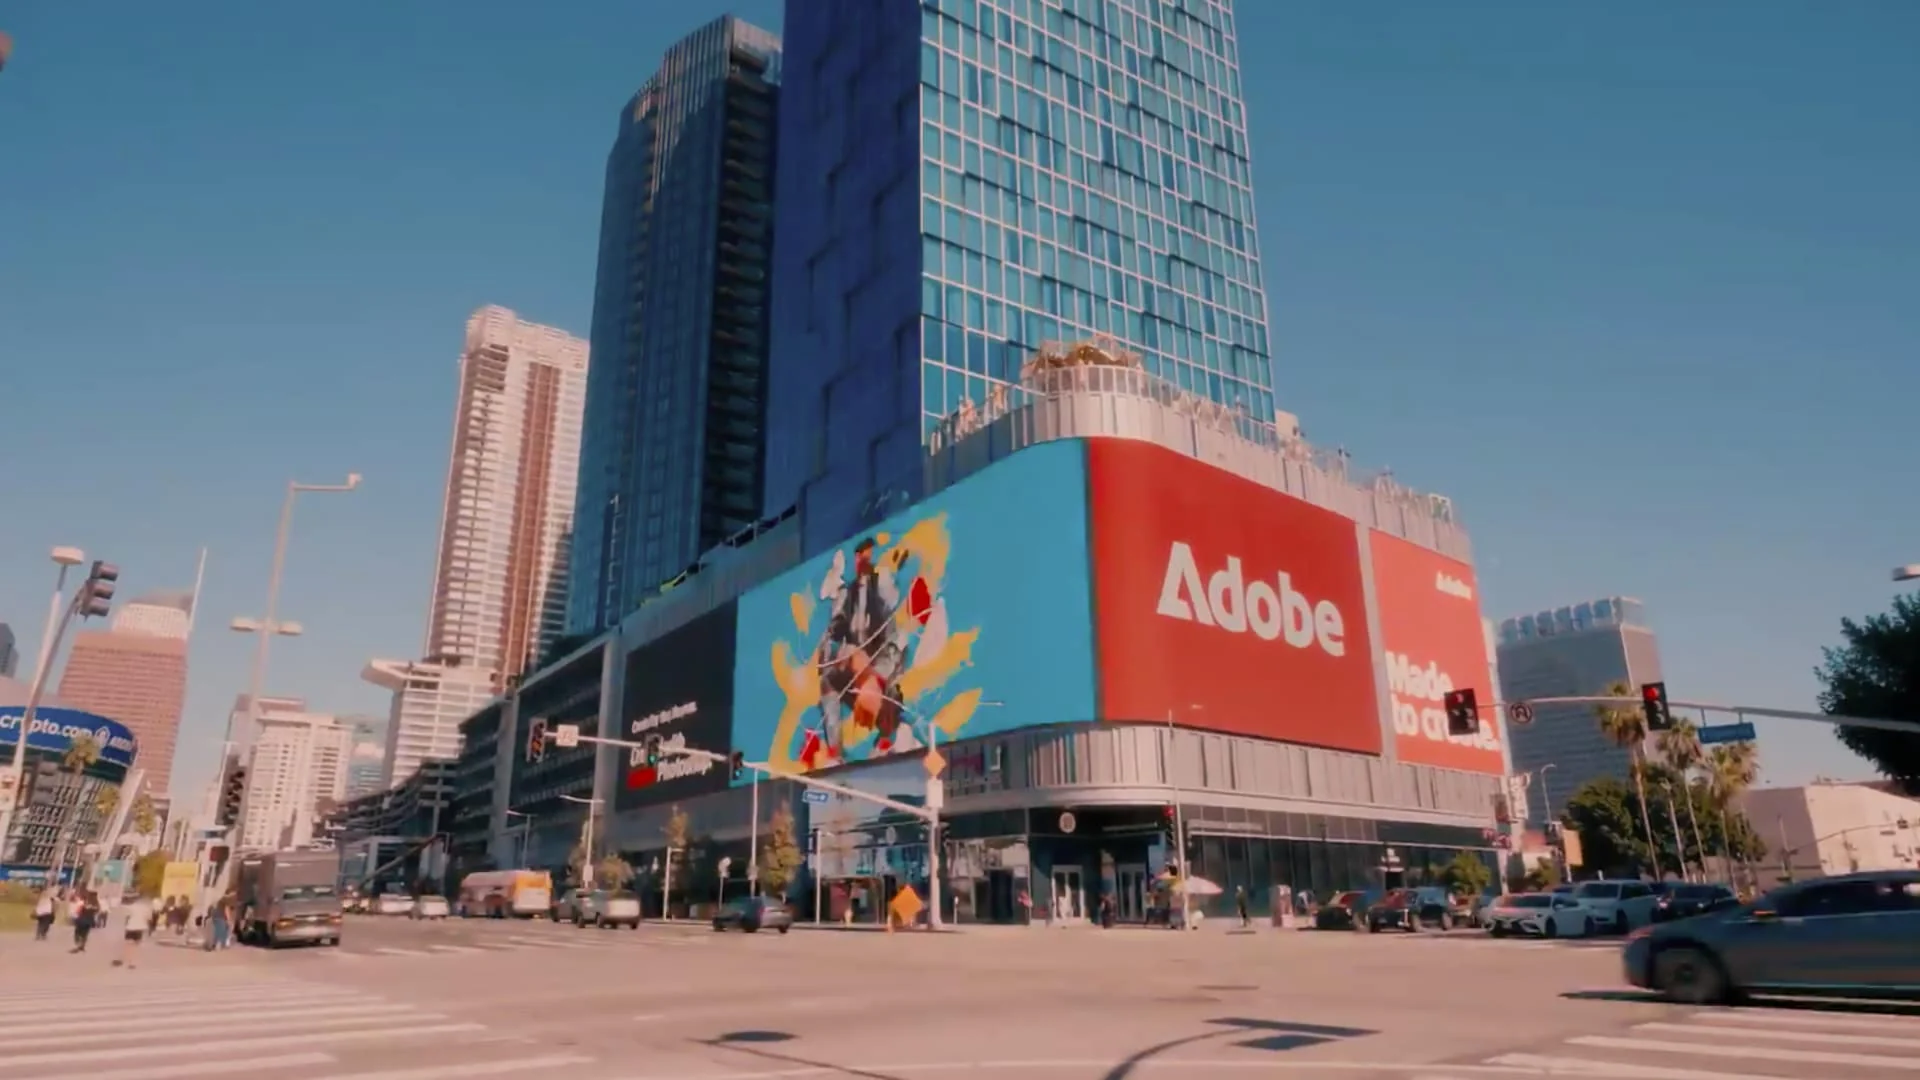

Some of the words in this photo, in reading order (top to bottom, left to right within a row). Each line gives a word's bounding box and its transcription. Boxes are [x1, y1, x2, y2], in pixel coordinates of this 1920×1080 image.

[1156, 541, 1346, 657] Adobe
[1385, 651, 1454, 701] Made
[0, 714, 93, 740] crpto.com
[1391, 693, 1419, 736] to
